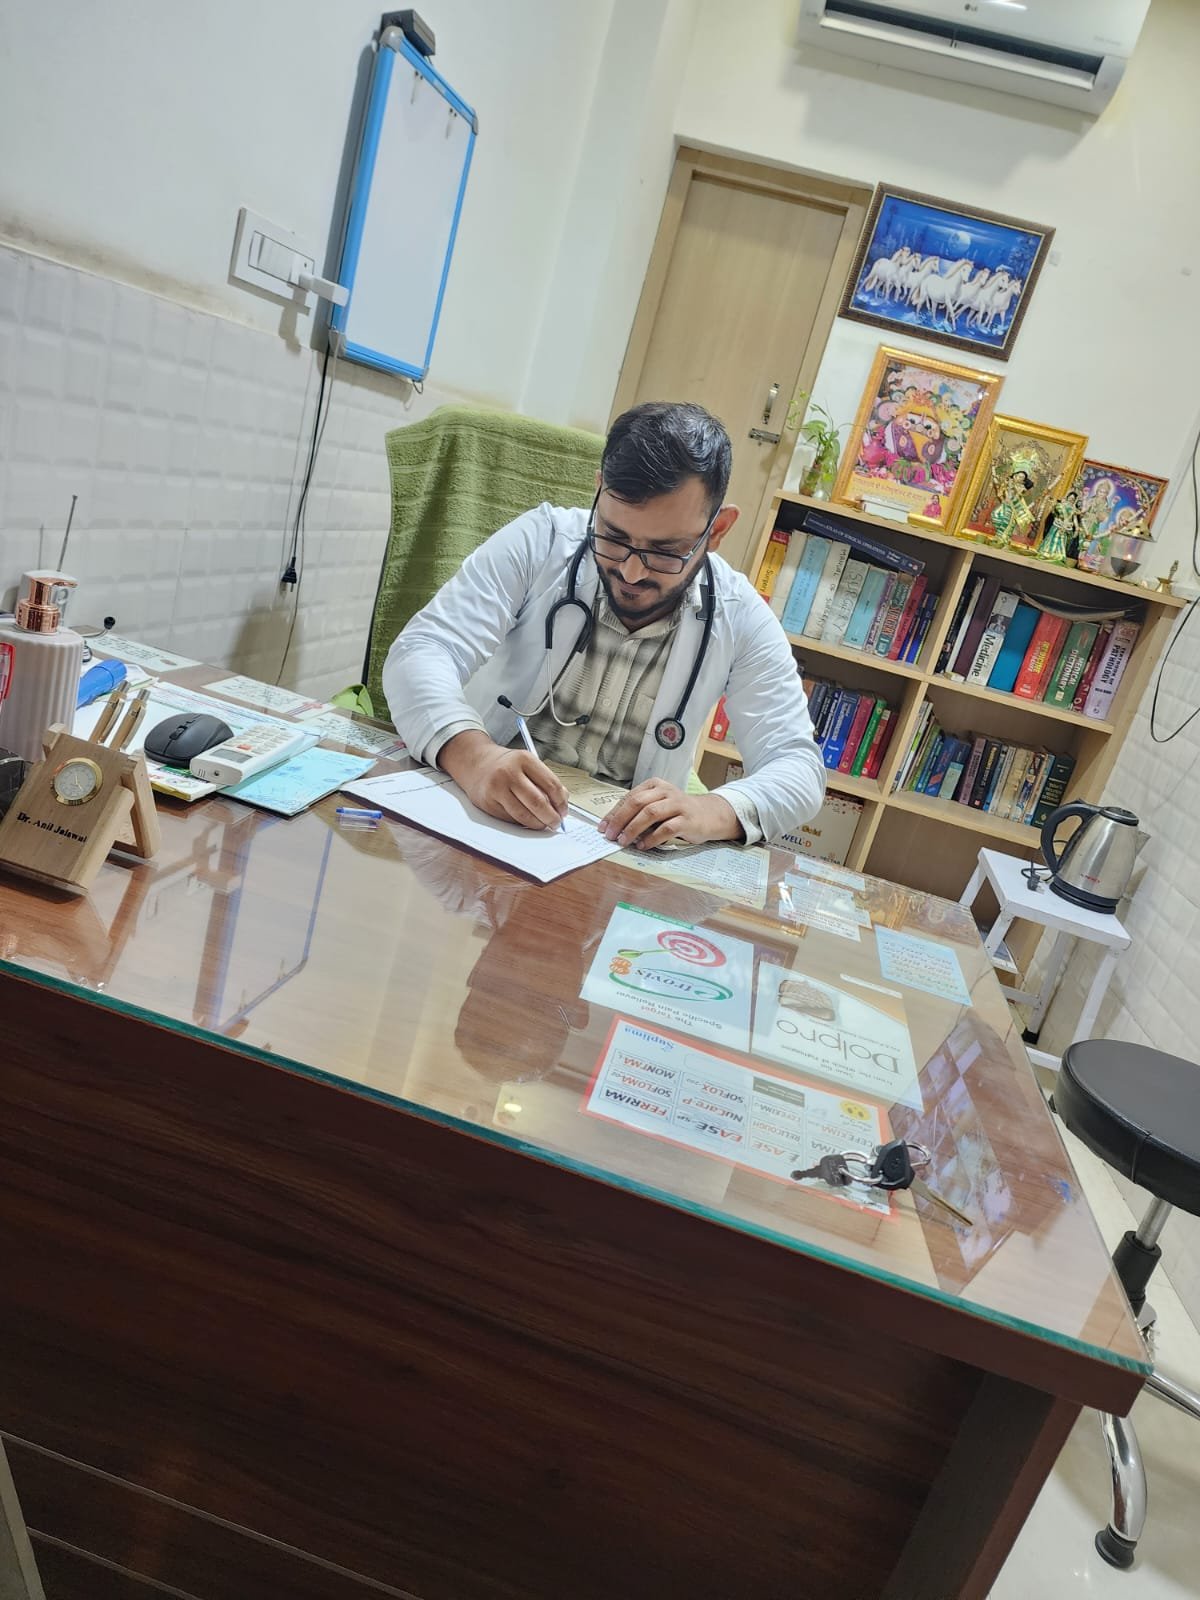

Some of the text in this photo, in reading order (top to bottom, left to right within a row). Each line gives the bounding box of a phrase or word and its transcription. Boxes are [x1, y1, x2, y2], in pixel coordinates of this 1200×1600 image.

[759, 567, 774, 593] Surgery
[815, 547, 847, 629] MANUAL OF SURGERY
[831, 570, 863, 632] SURGERY
[881, 605, 901, 636] SURGERY
[970, 633, 996, 678] Medicine
[1057, 648, 1078, 690] DICTIONARY
[1067, 655, 1084, 686] MEDICAL
[1099, 643, 1121, 683] PATHOLOGY
[17, 810, 32, 823] Dr.
[32, 818, 54, 832] Anil
[615, 990, 722, 1029] Specific Pain Reliever
[639, 1004, 692, 1026] The Target
[622, 1024, 675, 1051] Suplima
[775, 1018, 900, 1075] Dolpro
[603, 1088, 667, 1117] FERRIMA
[751, 1120, 800, 1142] RELICOUGH
